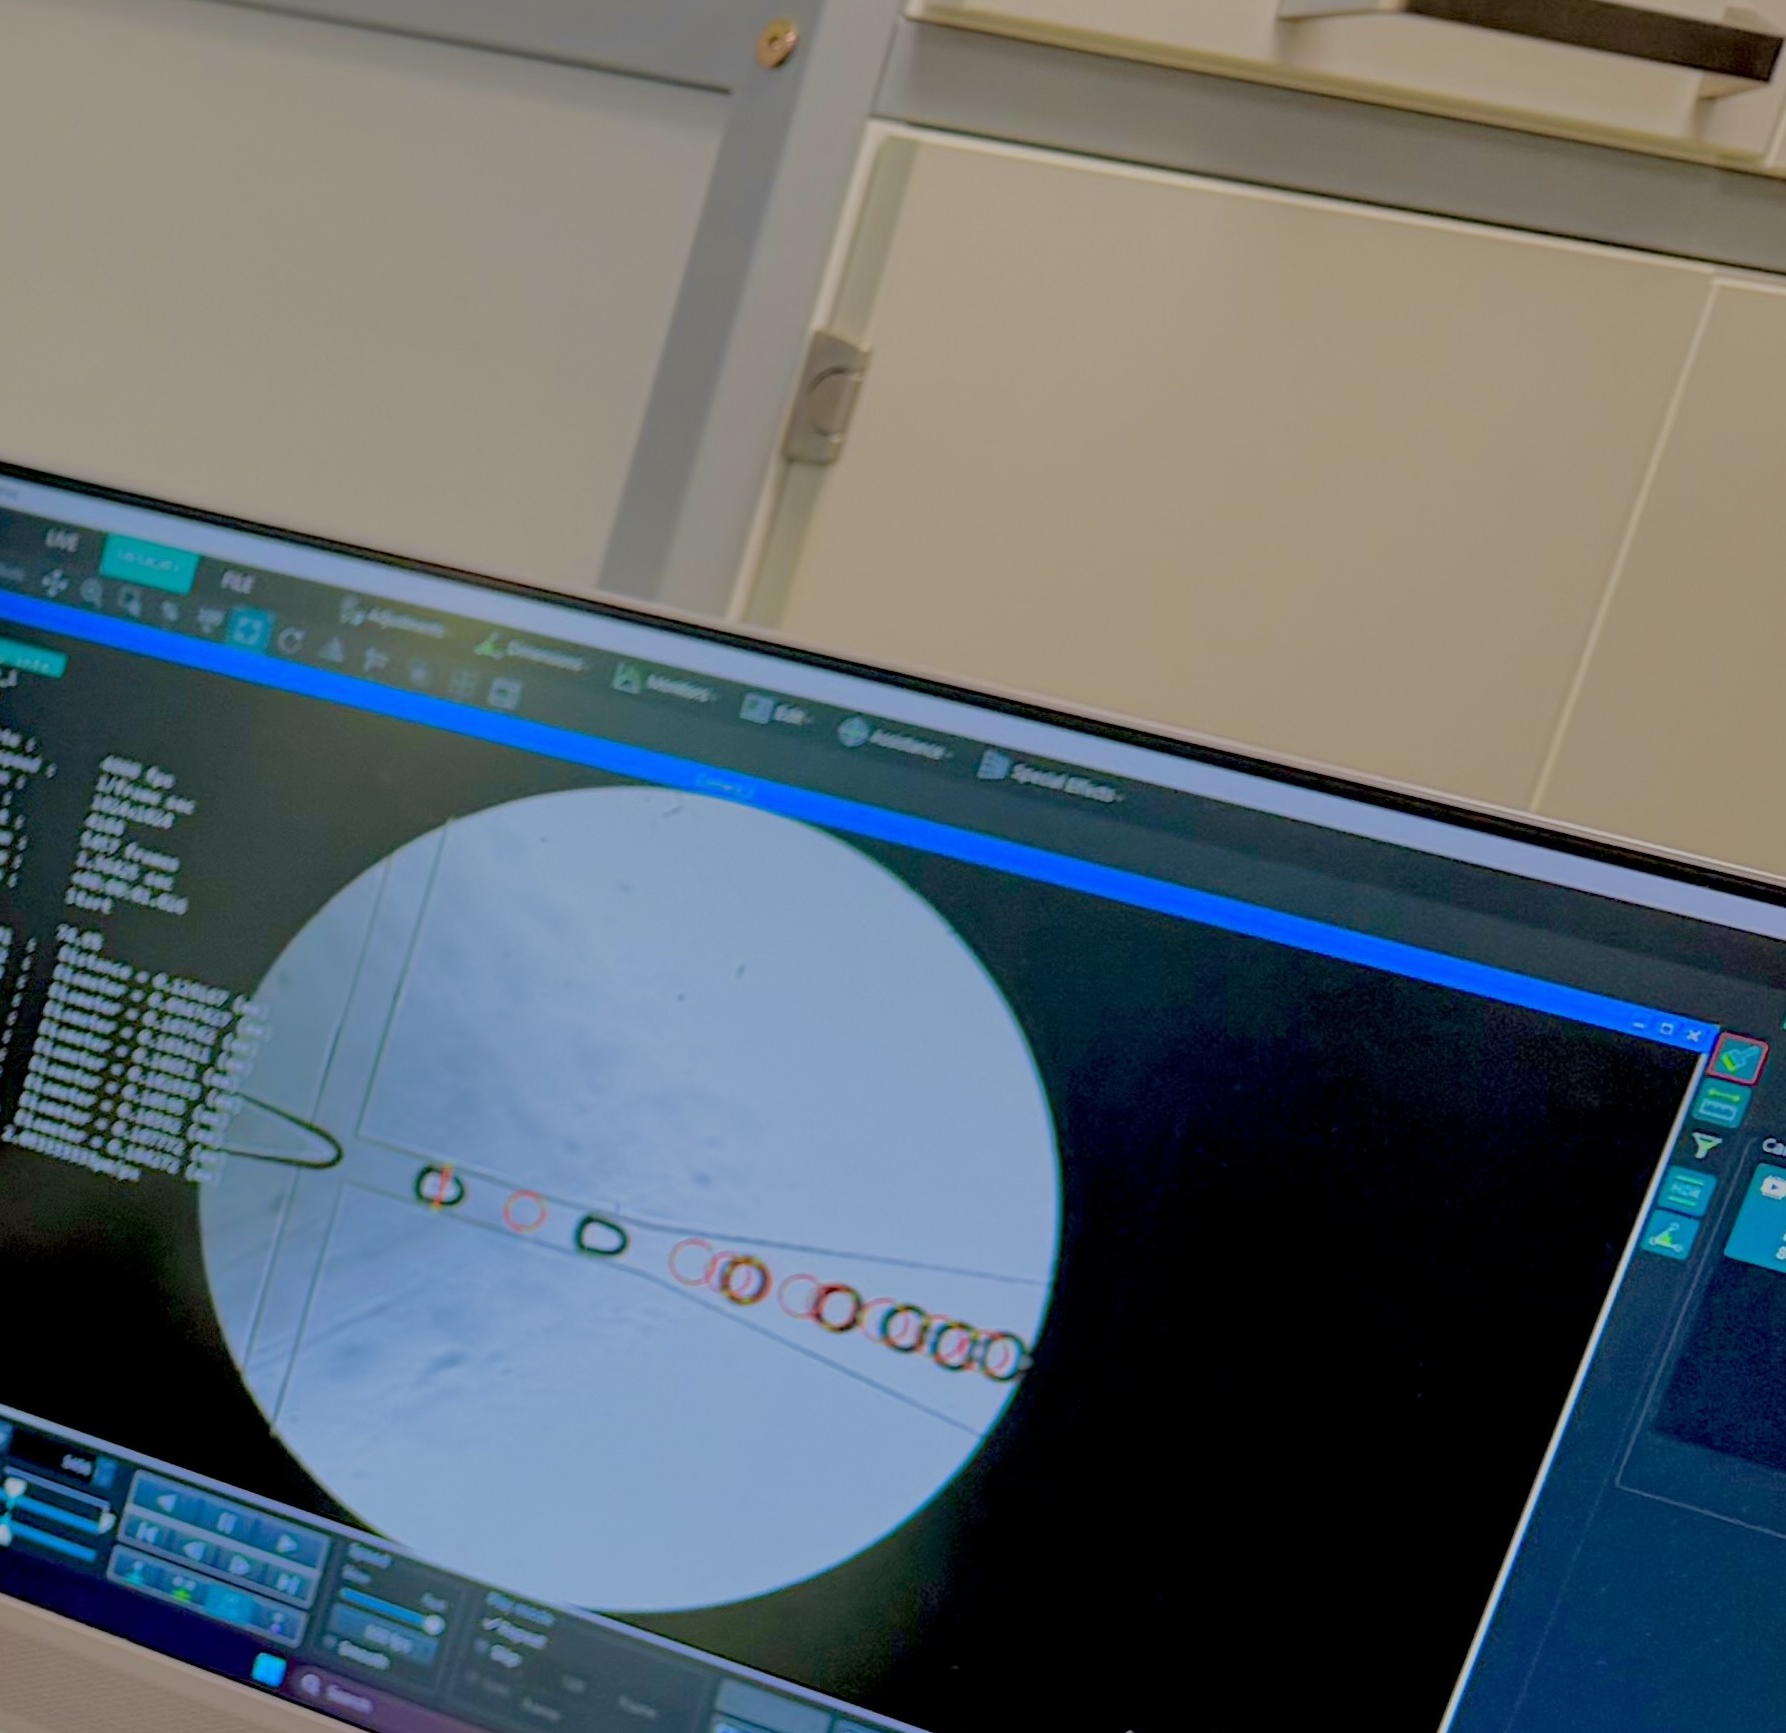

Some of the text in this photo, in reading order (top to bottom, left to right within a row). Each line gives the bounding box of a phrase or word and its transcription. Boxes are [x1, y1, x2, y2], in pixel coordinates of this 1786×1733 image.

[44, 528, 81, 553] LIVE
[220, 570, 257, 595] FILE
[772, 703, 806, 724] Edit
[143, 765, 176, 790] fps
[62, 887, 114, 915] Start
